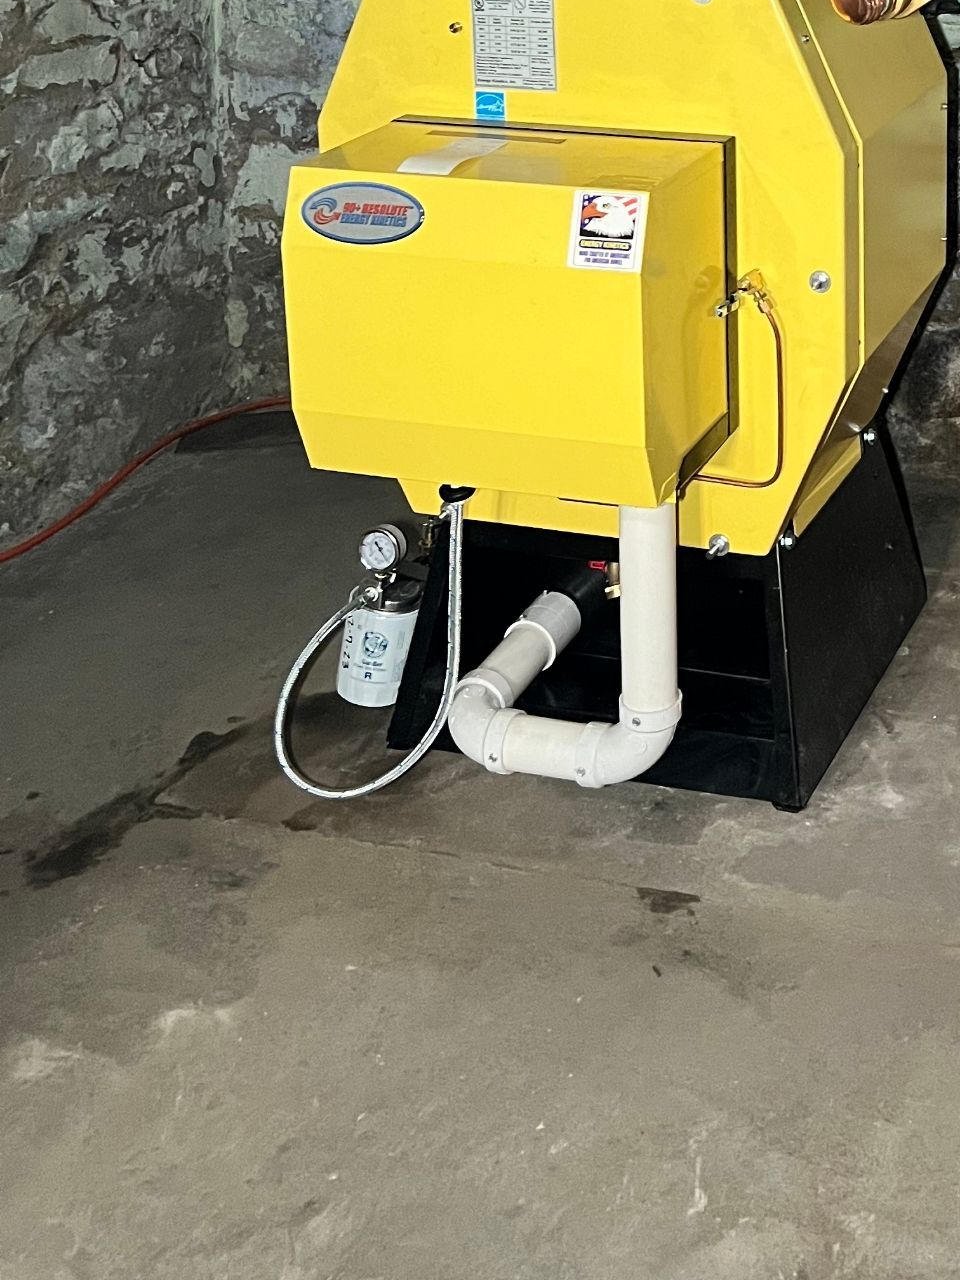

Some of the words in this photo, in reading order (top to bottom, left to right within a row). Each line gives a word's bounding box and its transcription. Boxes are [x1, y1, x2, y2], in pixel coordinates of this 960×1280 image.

[344, 203, 360, 213] 90+
[362, 204, 407, 216] RESOLUTE
[340, 214, 370, 224] ENERGY
[371, 216, 407, 227] KINETICS
